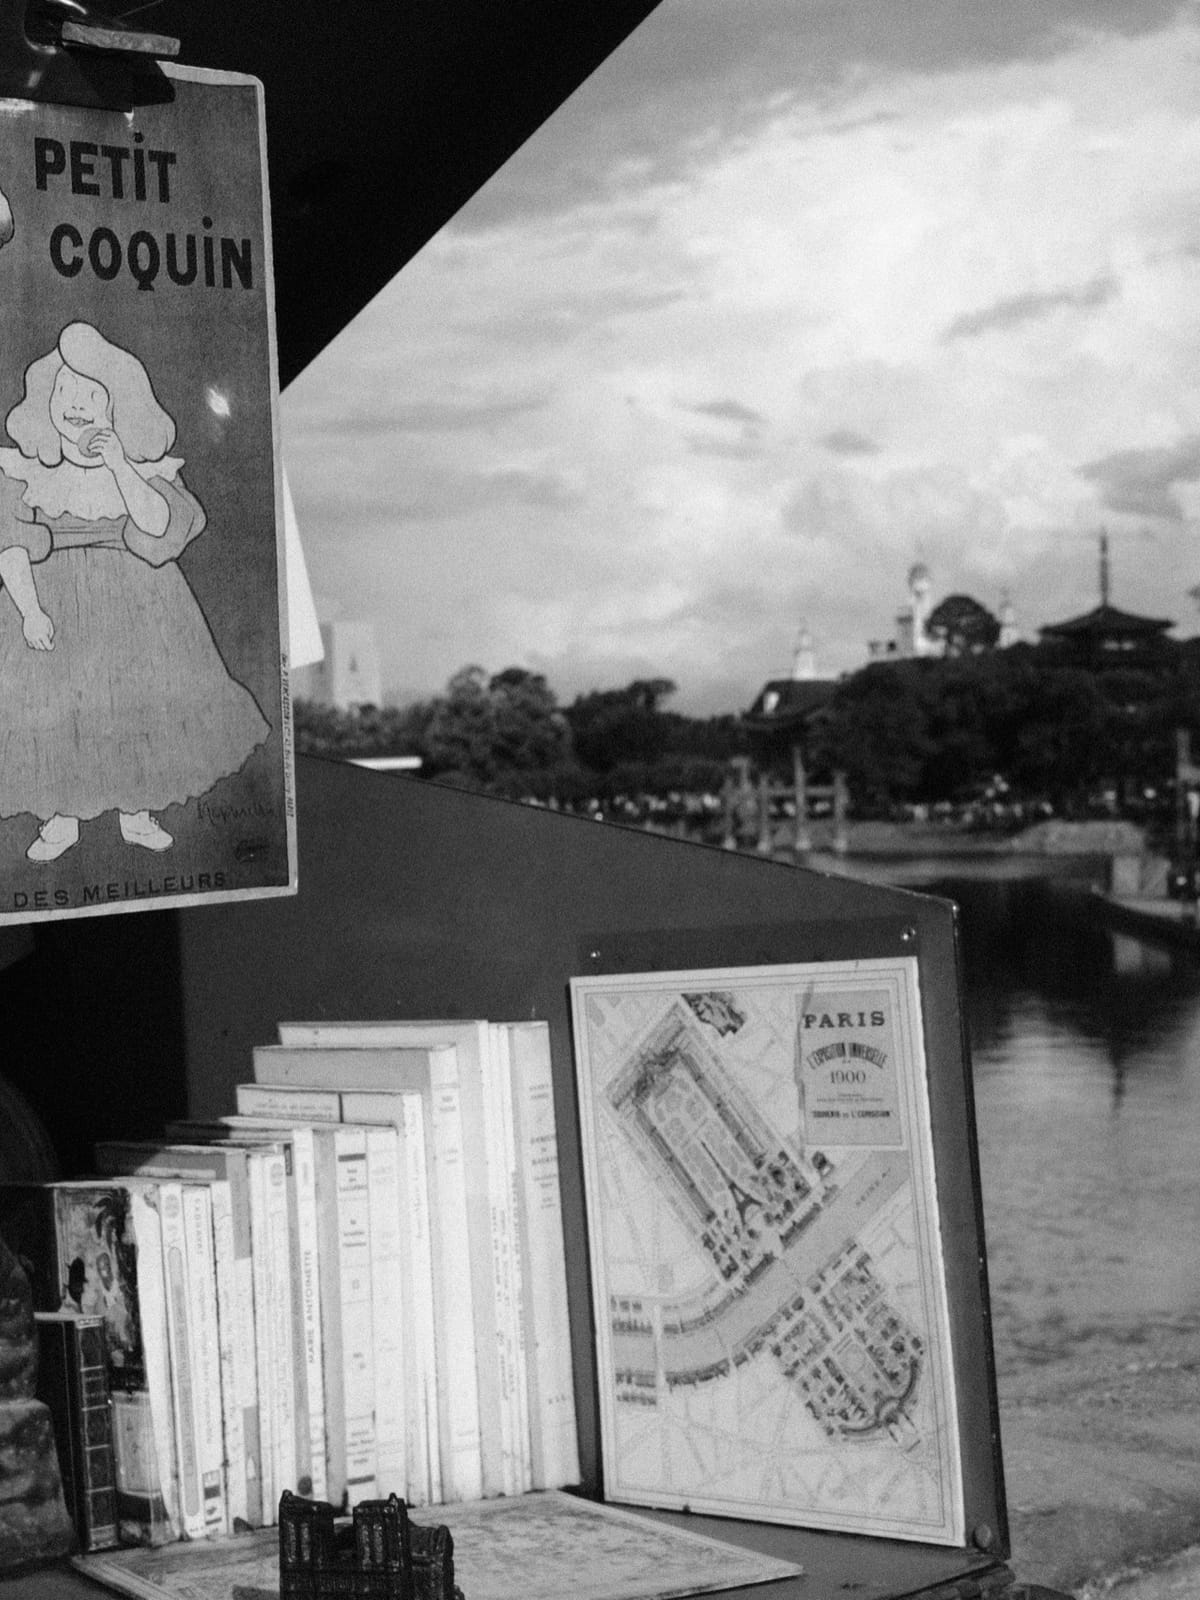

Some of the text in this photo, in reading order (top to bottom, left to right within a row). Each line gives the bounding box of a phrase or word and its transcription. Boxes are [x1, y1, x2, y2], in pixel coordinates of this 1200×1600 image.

[14, 889, 70, 909] DES
[83, 871, 227, 901] MEILLEURS
[803, 1011, 886, 1029] PARIS
[830, 1070, 867, 1085] 1900
[304, 1250, 316, 1365] MARIE ANTOINETTE
